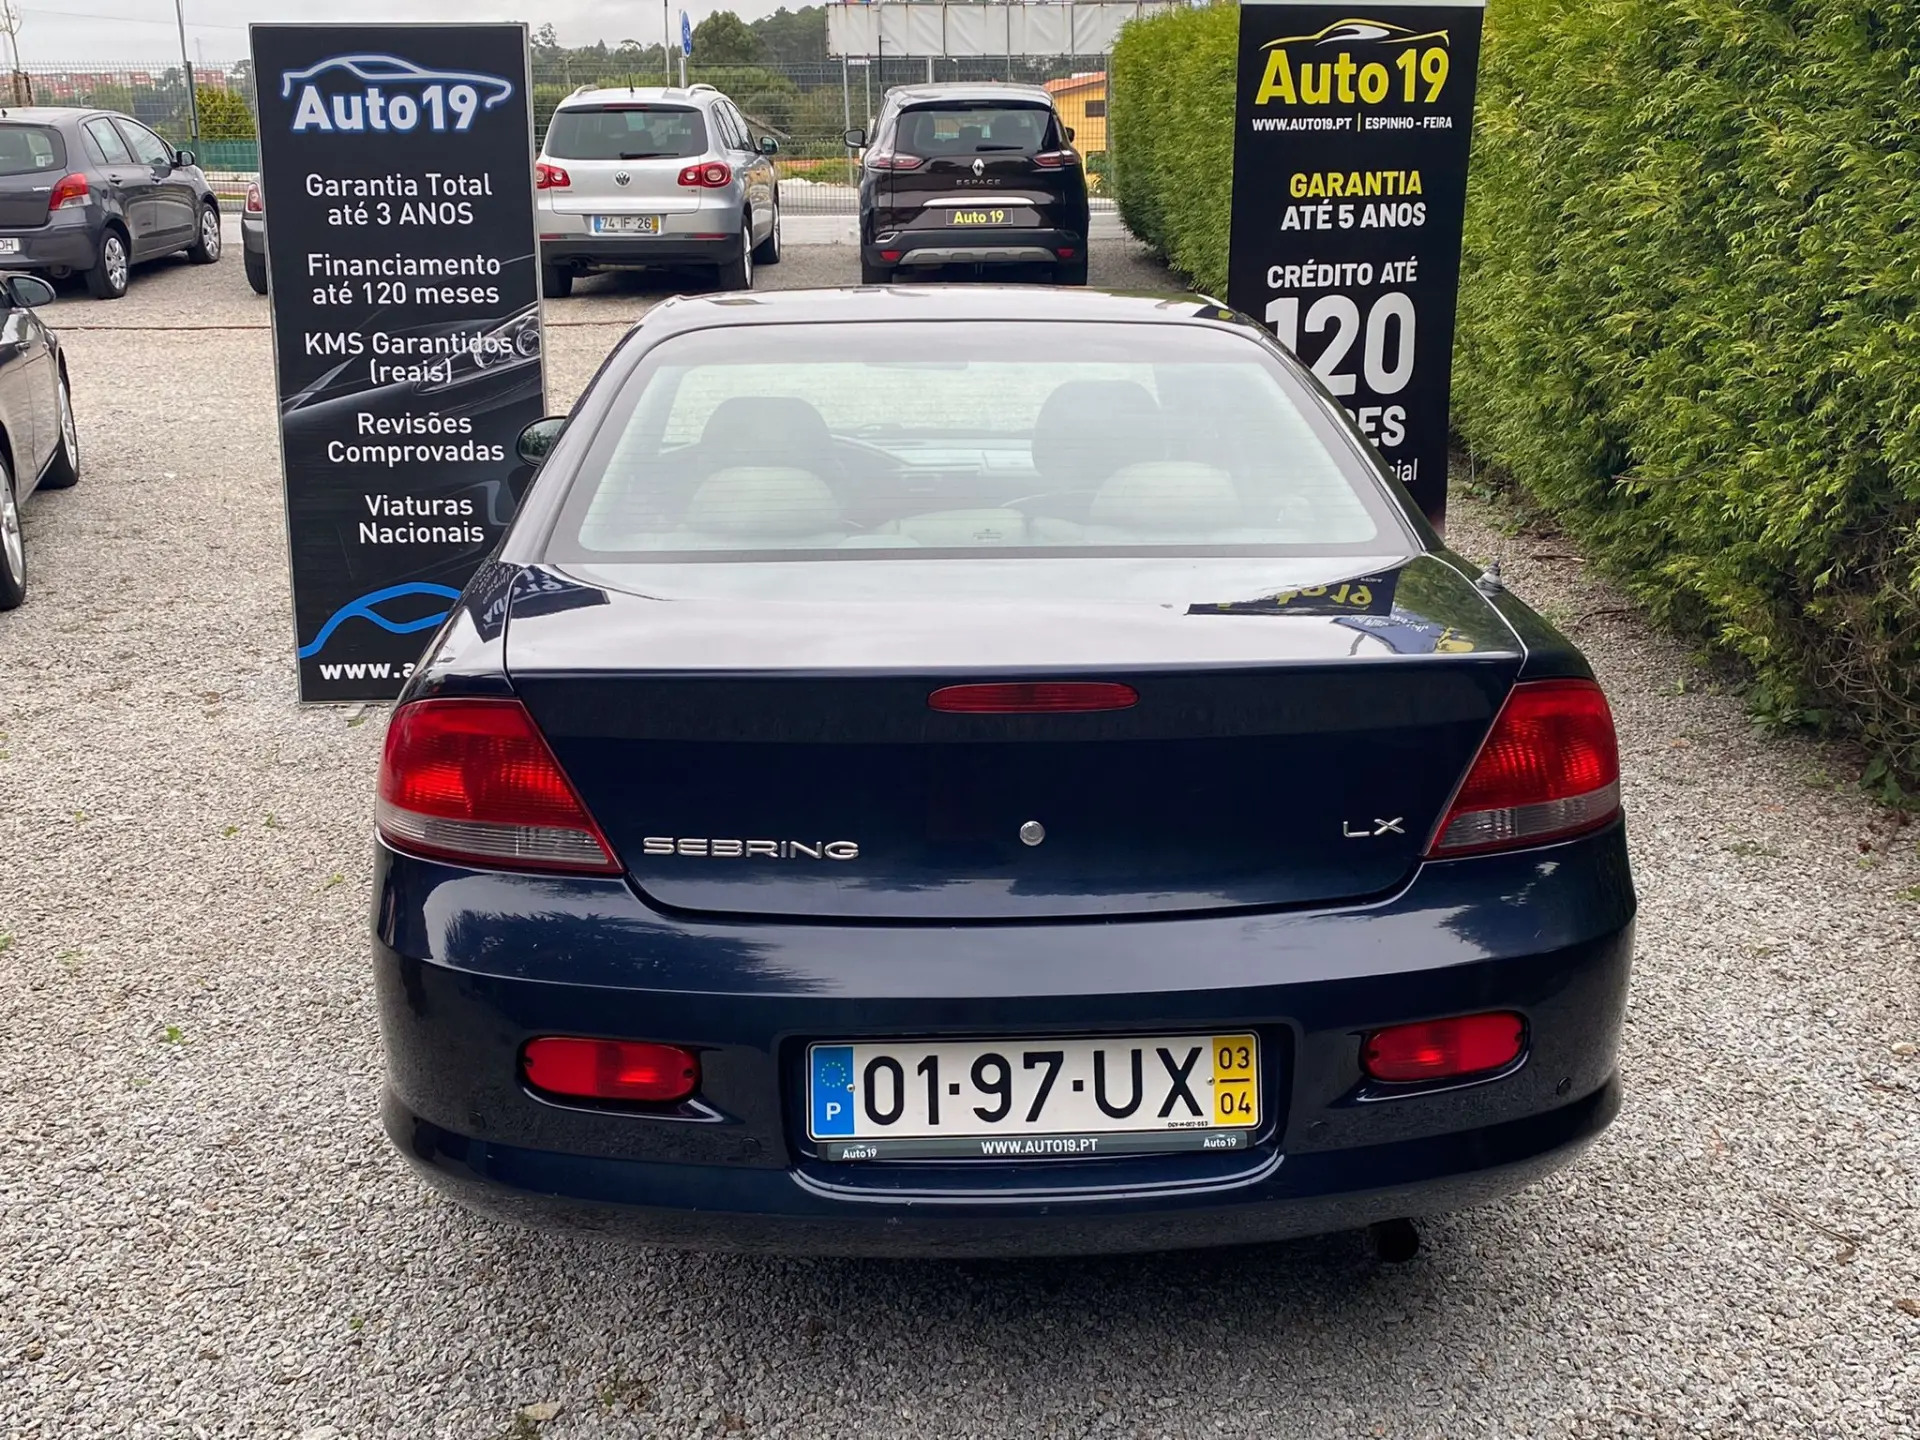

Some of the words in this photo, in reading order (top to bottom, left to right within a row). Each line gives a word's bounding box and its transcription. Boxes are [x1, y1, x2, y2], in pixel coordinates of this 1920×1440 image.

[1254, 49, 1390, 105] Auto
[1395, 47, 1450, 103] 19
[293, 84, 478, 130] Auto19
[1252, 117, 1352, 131] WWW.AUTO19.PT
[1365, 116, 1414, 130] ESPINHO
[1423, 116, 1453, 129] FEIRA
[305, 173, 418, 197] Garantia
[426, 172, 493, 196] Total
[1289, 170, 1422, 198] GARANTIA
[327, 202, 369, 225] até
[376, 204, 392, 225] 3
[399, 202, 474, 225] ANOS
[953, 211, 987, 224] Auto
[990, 209, 1005, 223] 19
[1280, 199, 1333, 231] ATÉ
[1338, 204, 1355, 229] 5
[1360, 202, 1426, 229] ANOS
[307, 253, 501, 277] Financiamento
[1266, 259, 1374, 289] CRÉDITO
[1379, 255, 1419, 284] ATÉ
[312, 281, 353, 304] até
[363, 282, 407, 305] 120
[415, 286, 500, 304] meses
[304, 332, 364, 355] KMS
[372, 331, 513, 355] Garantidos
[1264, 291, 1417, 397] 120
[370, 358, 452, 385] (reais)
[357, 412, 473, 435] Revisões
[327, 440, 505, 468] Comprovadas
[364, 494, 473, 517] Viaturas
[359, 522, 485, 544] Nacionais
[319, 663, 416, 680] www.a
[1343, 817, 1405, 838] LX
[643, 837, 859, 861] SEBRING
[1219, 1046, 1250, 1070] 03
[825, 1102, 842, 1121] P
[1220, 1092, 1252, 1115] 04
[981, 1138, 1099, 1154] WWW.AUTO19.PT
